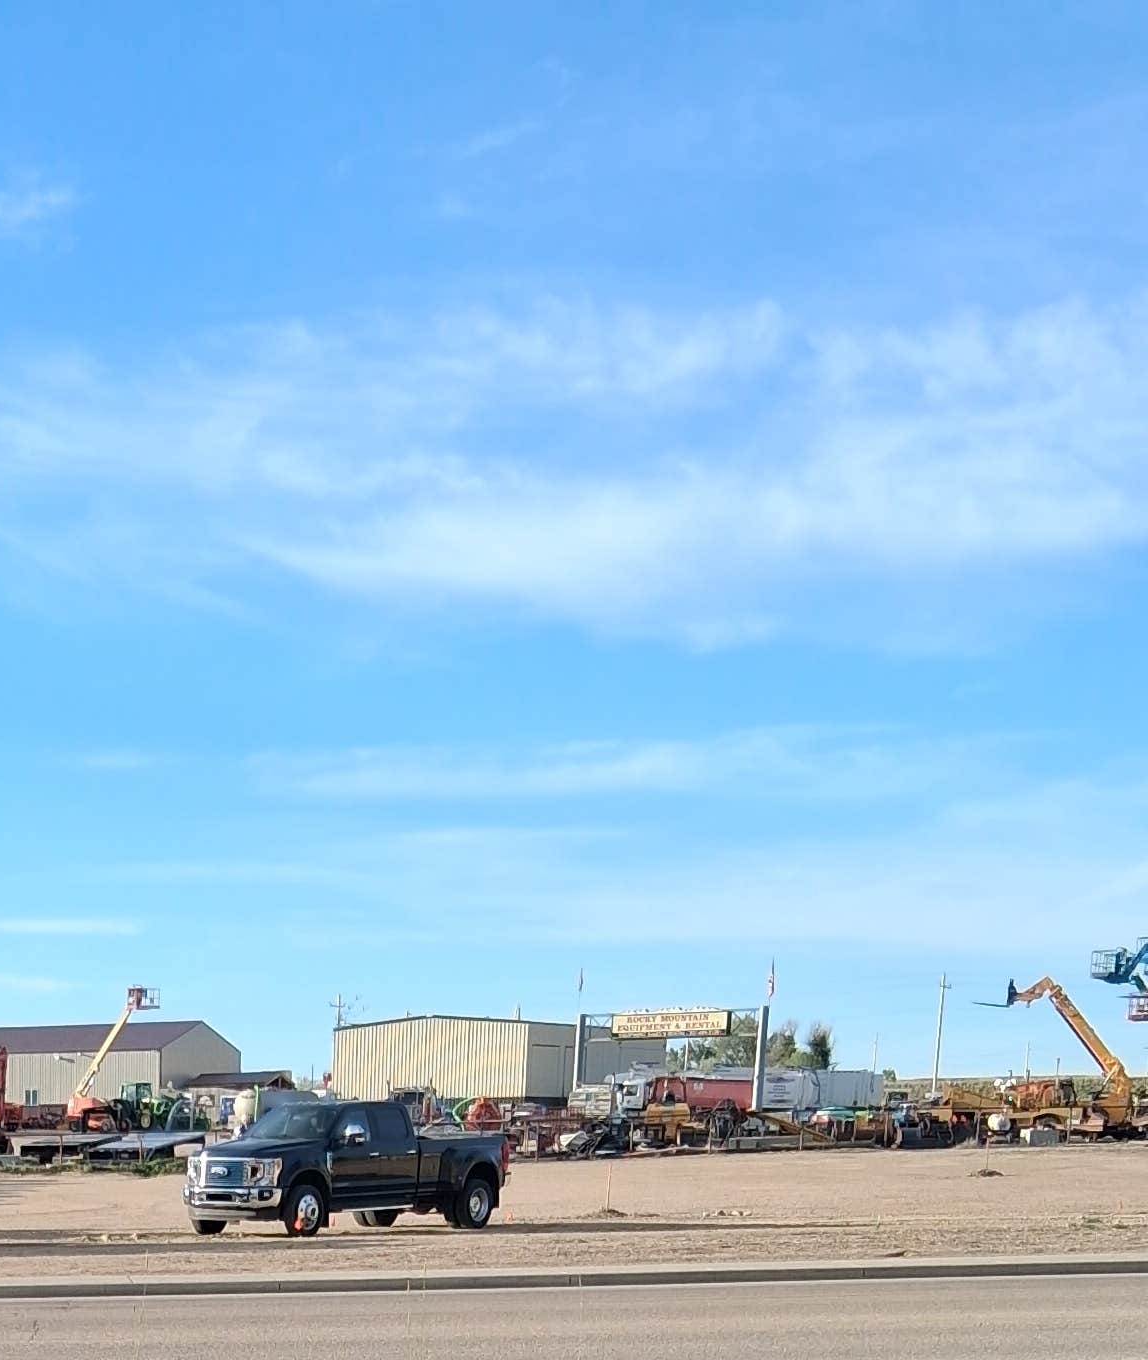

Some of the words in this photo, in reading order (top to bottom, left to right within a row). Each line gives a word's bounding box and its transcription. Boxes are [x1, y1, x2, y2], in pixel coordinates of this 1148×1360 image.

[627, 1015, 657, 1024] ROCKY
[661, 1013, 709, 1023] MOUNTAIN
[617, 1023, 672, 1032] EQUIPMENT
[685, 1021, 722, 1030] RENTAL
